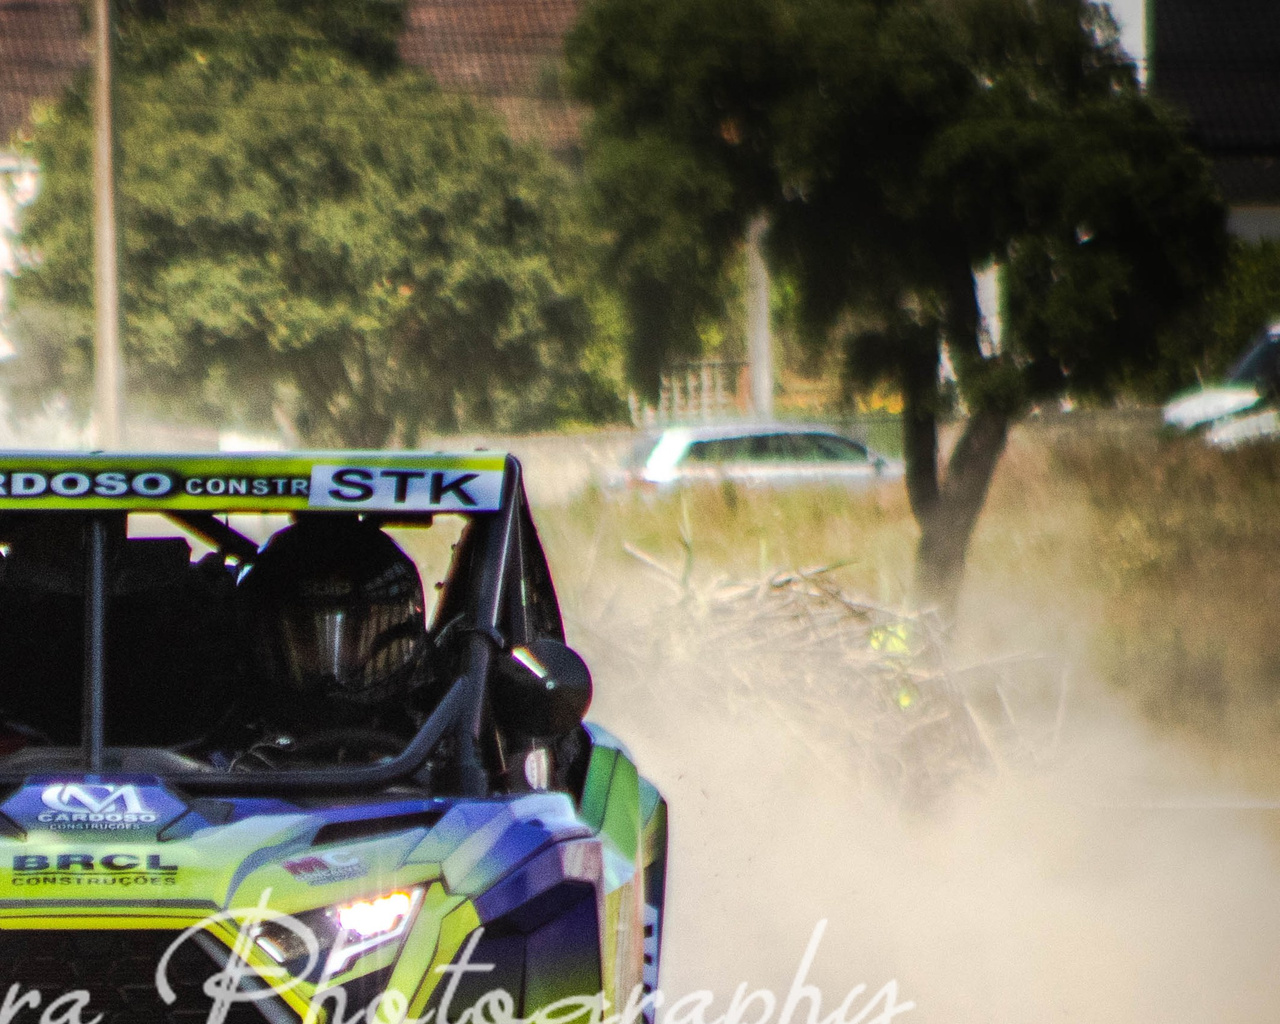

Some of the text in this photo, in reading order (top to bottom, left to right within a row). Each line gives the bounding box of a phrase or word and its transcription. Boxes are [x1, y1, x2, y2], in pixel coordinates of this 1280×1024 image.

[185, 477, 310, 495] CONSTR
[328, 468, 481, 507] STK
[38, 814, 157, 822] CARDOSO
[13, 854, 179, 871] BRCL
[12, 875, 176, 887] CONSTRUÇÕES
